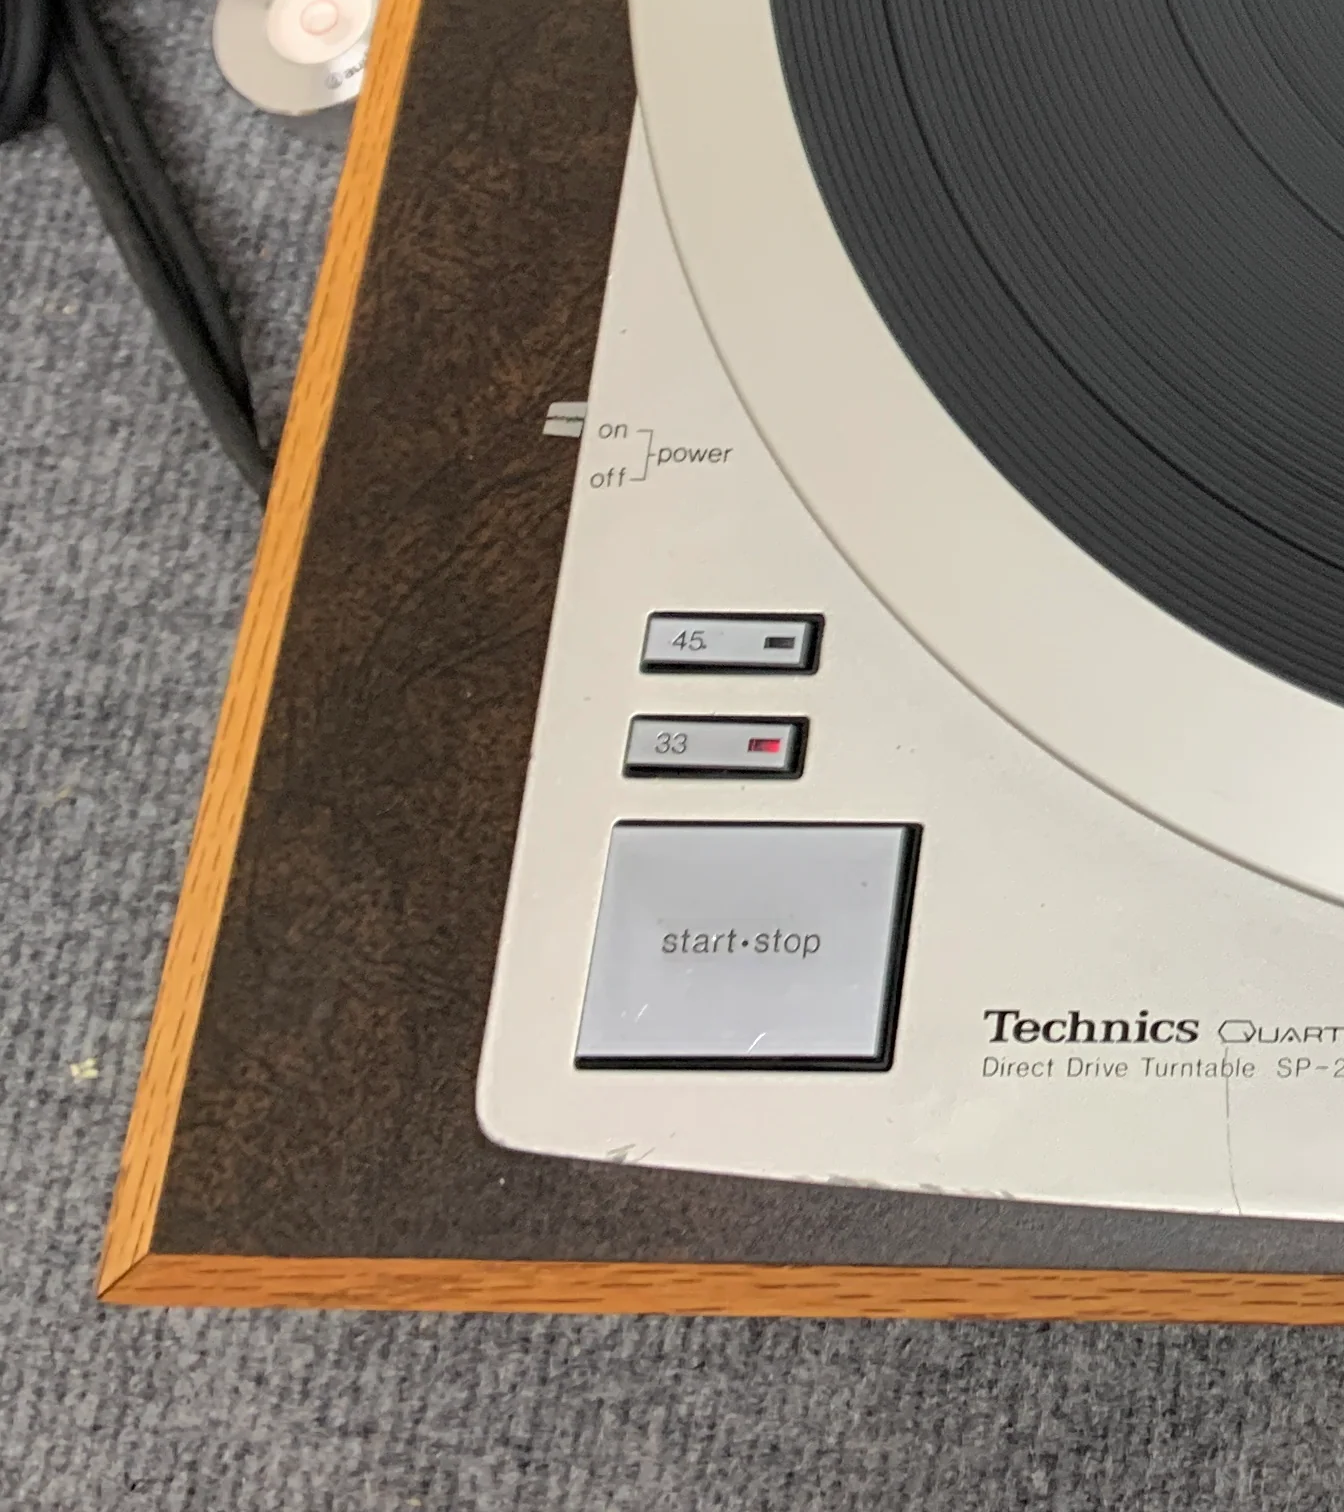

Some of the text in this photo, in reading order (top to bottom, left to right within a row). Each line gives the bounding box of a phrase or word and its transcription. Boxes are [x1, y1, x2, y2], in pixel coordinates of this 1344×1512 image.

[598, 423, 628, 439] on
[657, 447, 734, 466] power
[589, 467, 627, 488] off
[654, 731, 688, 754] 33
[983, 1009, 1200, 1044] Technics
[982, 1056, 1054, 1078] Direct
[1066, 1056, 1128, 1078] Drive
[1141, 1056, 1255, 1078] Turntable
